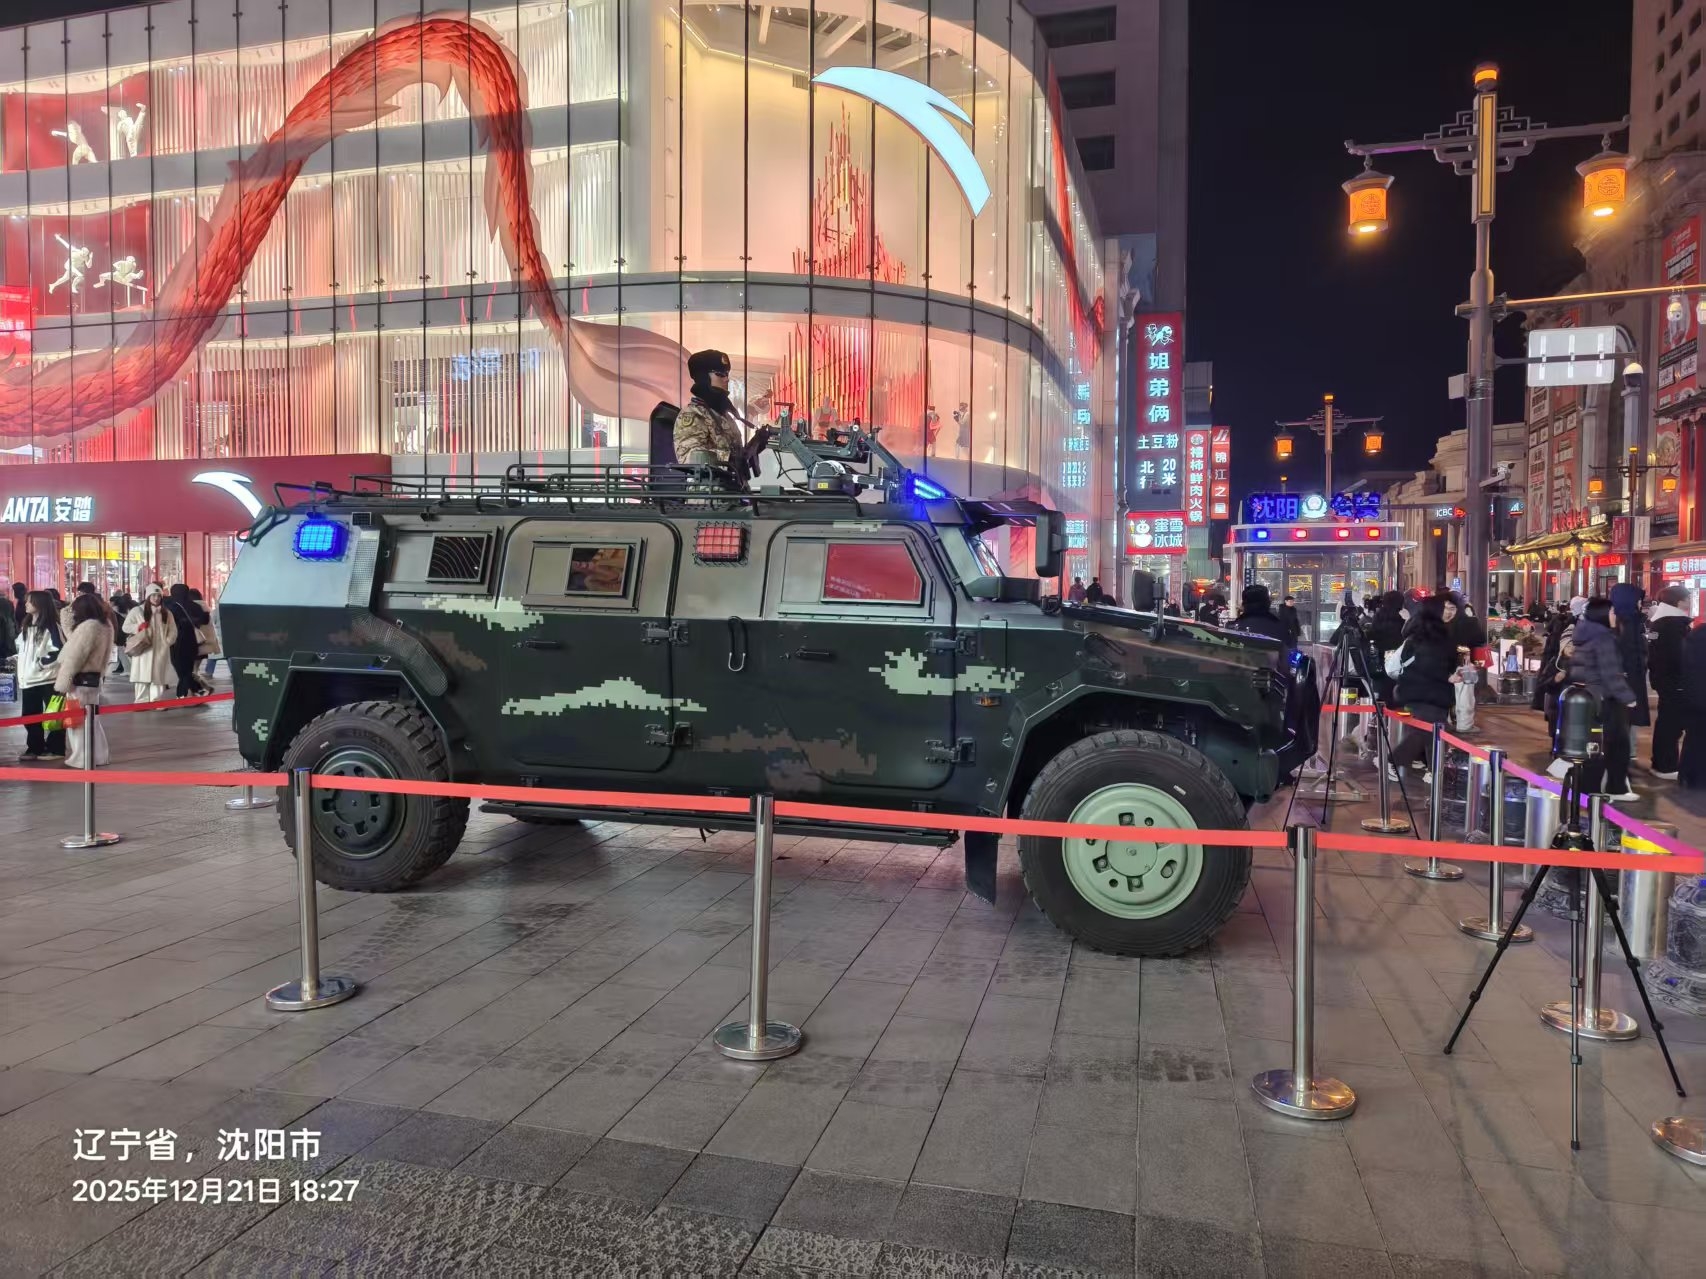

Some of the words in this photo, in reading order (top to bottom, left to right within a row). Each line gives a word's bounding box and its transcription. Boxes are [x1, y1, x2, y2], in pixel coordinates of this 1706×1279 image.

[1148, 352, 1170, 423] 姐弟俩
[1137, 433, 1179, 450] 土豆粉
[1214, 451, 1227, 514] 锦江之星
[0, 496, 49, 523] ANTA
[54, 496, 93, 522] 安踏
[1252, 496, 1299, 520] 沈阳
